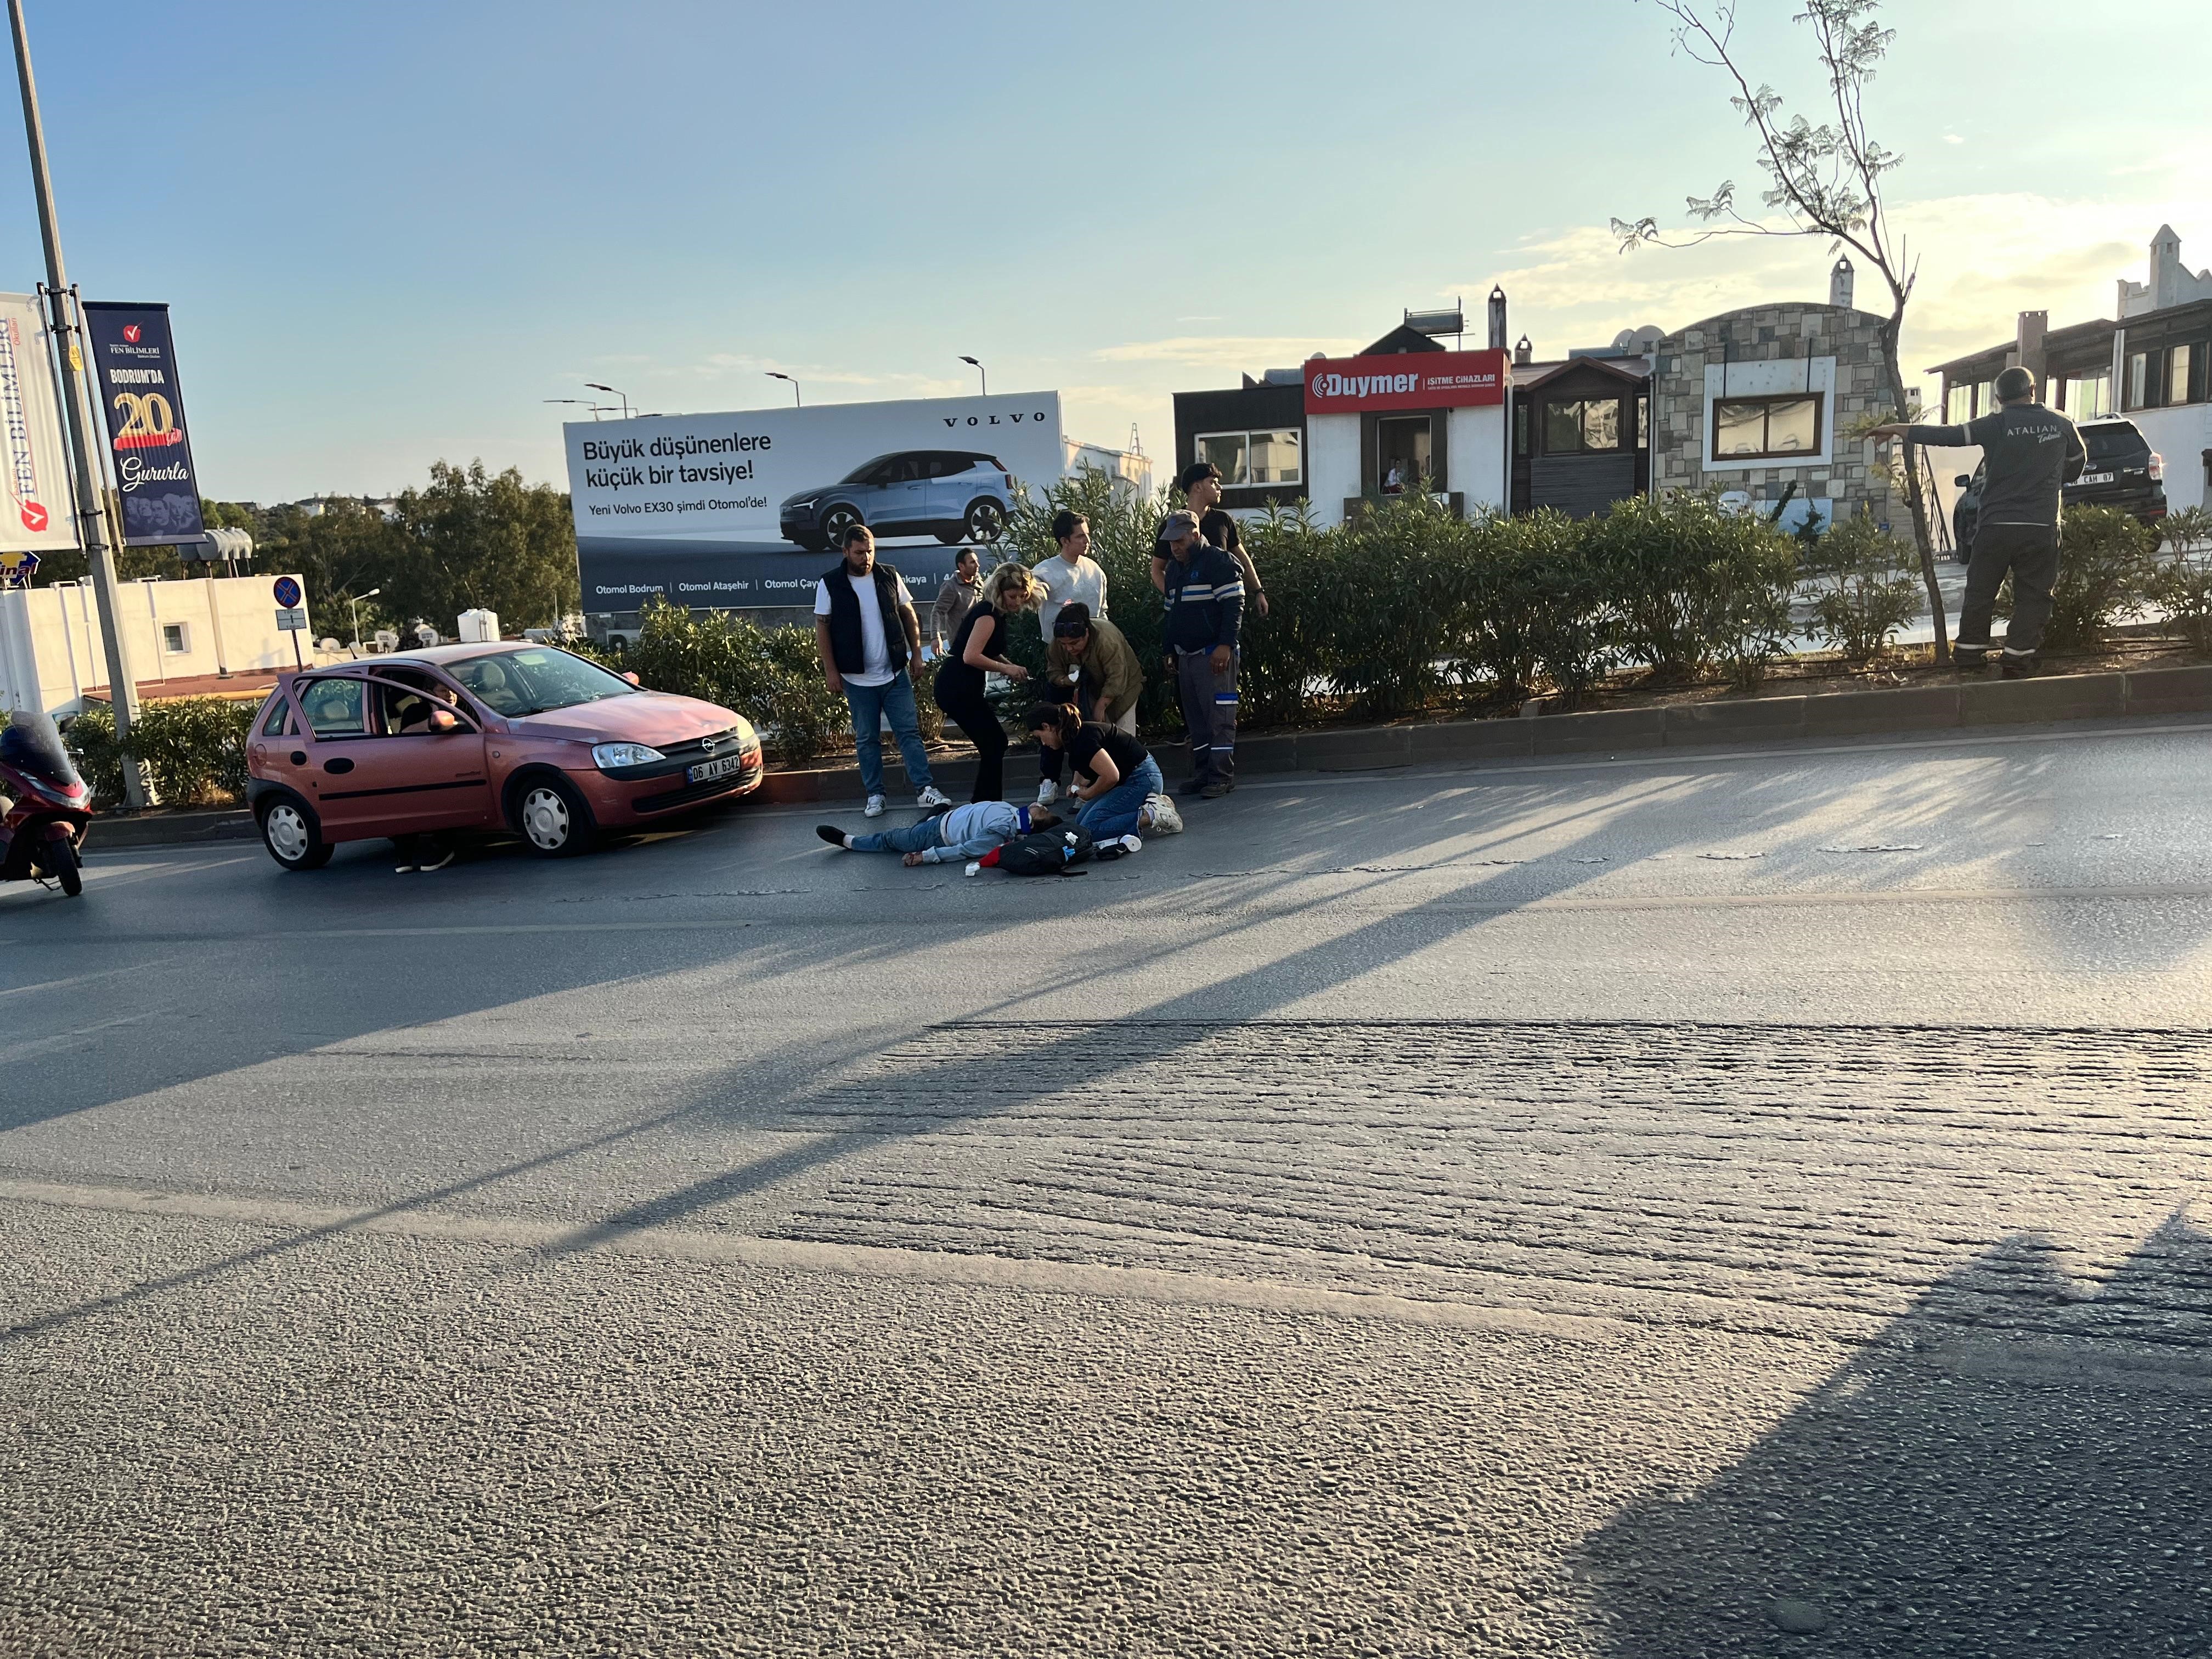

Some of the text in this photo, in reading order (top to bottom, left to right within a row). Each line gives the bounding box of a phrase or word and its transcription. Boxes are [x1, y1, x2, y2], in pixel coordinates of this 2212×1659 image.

[125, 346, 160, 354] BİLİMLERİ
[110, 369, 165, 384] BODRUM'DA
[1326, 373, 1419, 398] Duymer
[1455, 374, 1495, 383] CİHAZLARI
[114, 392, 173, 437] 20
[943, 412, 1045, 428] VOLVO
[2007, 425, 2057, 437] ATALIAN
[583, 432, 771, 463] Büyük düşünenlere
[13, 449, 35, 495] FEN
[120, 456, 189, 492] Gururla
[586, 460, 753, 491] küçük bir tavsiye!
[589, 496, 768, 515] Yeni Volvo EX30 şimdi Otomol'de!
[596, 585, 627, 594] Otomol
[629, 584, 663, 593] Bodrum
[679, 582, 711, 591] Otomol
[713, 580, 749, 591] Ataşehir
[765, 579, 798, 588] Otomol
[693, 766, 703, 780] 06
[722, 757, 739, 772] 6342
